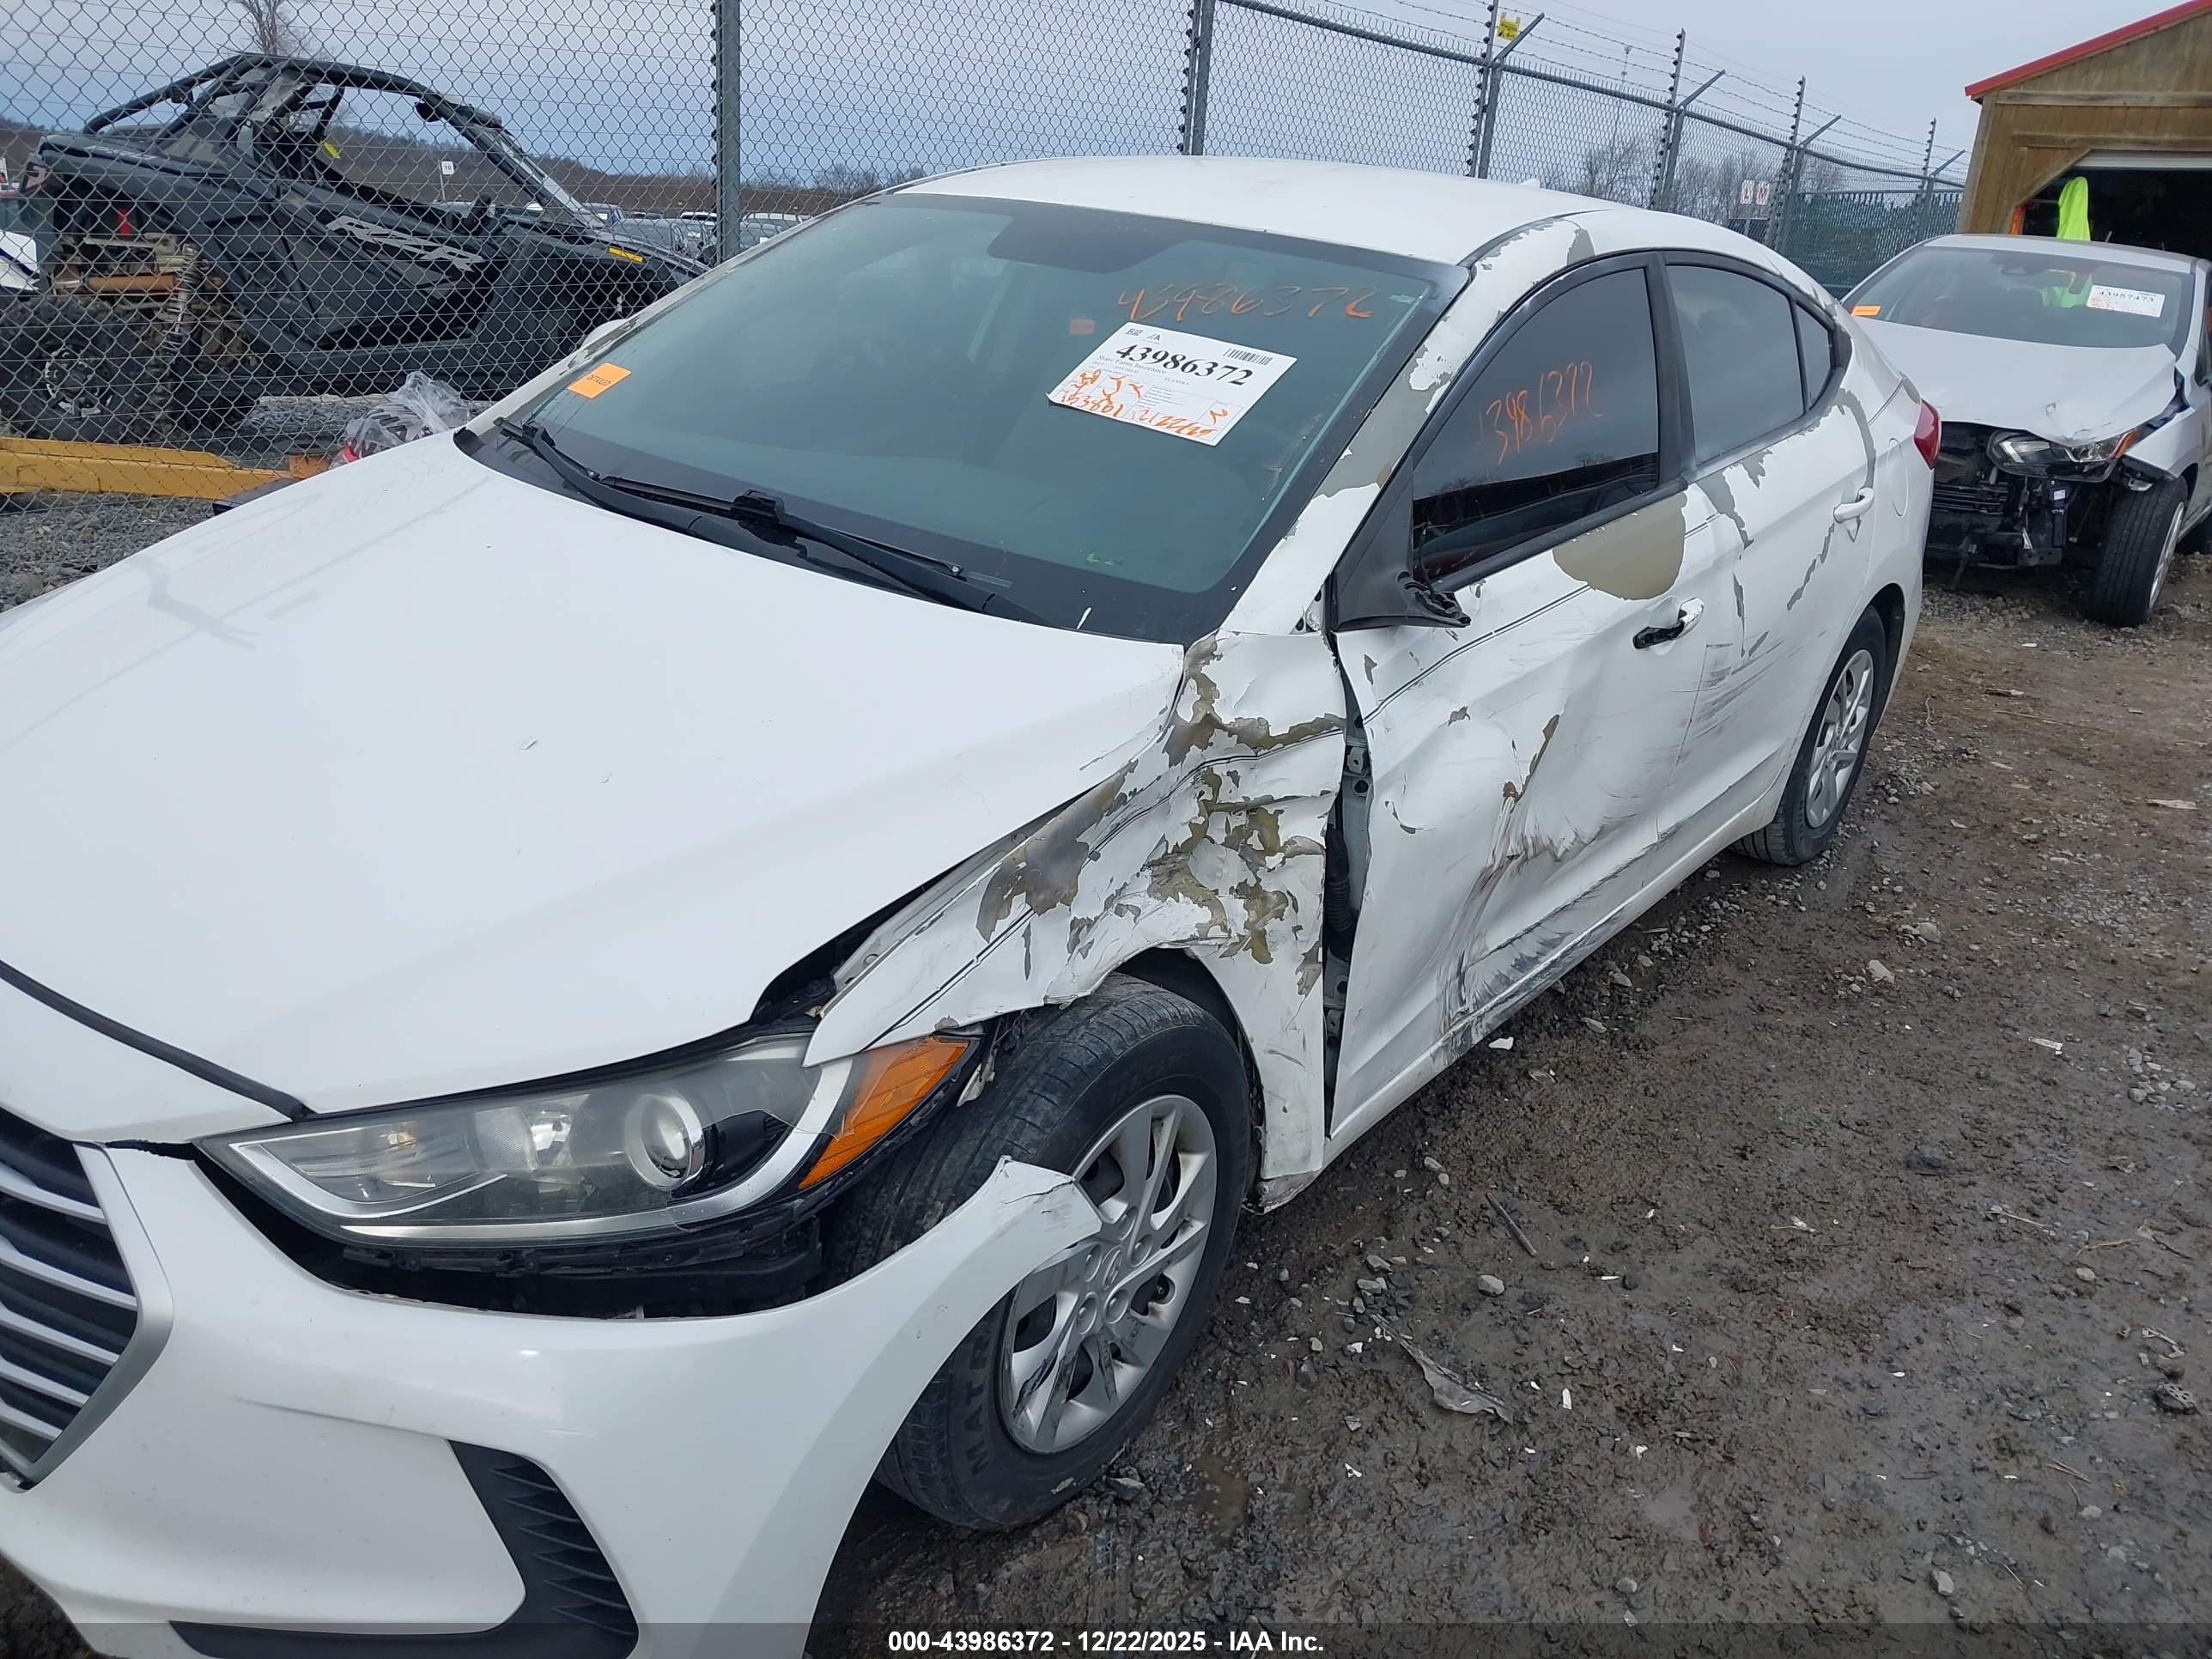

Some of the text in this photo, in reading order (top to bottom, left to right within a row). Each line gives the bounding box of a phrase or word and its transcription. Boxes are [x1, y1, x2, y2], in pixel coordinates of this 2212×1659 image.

[1098, 355, 1115, 363] State
[1115, 359, 1133, 368] Farm
[1134, 362, 1168, 375] Insurance
[1116, 343, 1253, 386] 43986372
